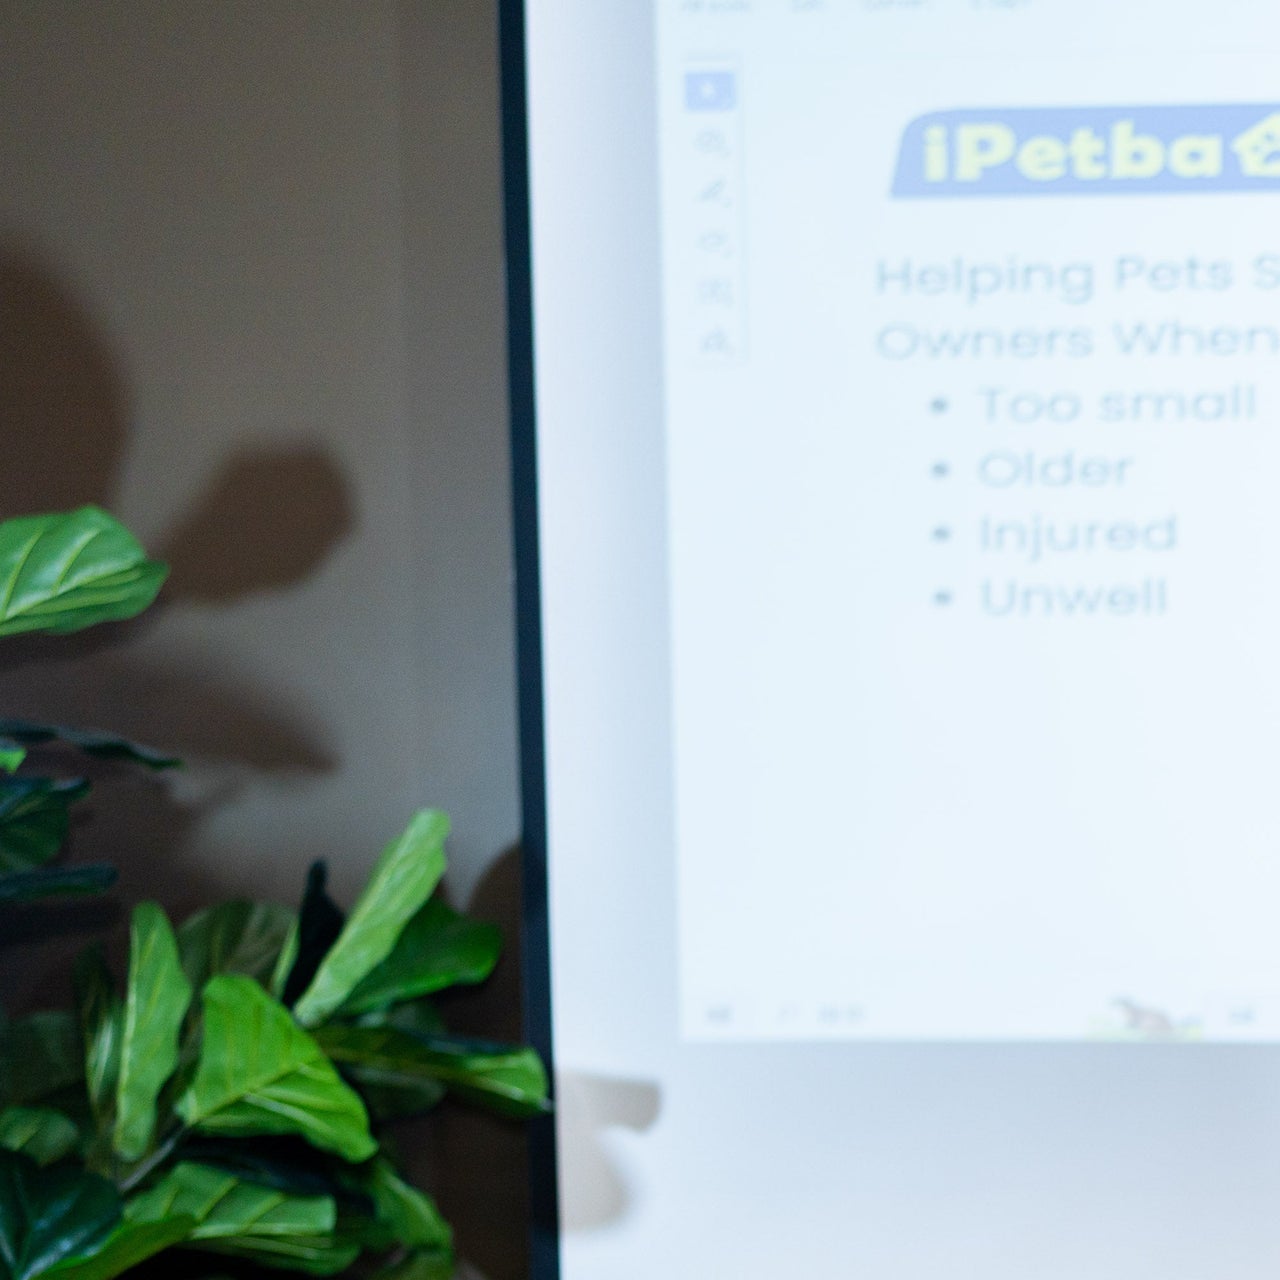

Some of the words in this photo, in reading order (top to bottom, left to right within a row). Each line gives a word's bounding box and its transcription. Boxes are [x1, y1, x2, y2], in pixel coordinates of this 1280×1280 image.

[922, 118, 1220, 183] iPetba
[875, 255, 1093, 304] Helping
[1115, 254, 1233, 293] Pets
[875, 320, 1093, 360] Owners
[1112, 318, 1280, 356] When
[976, 385, 1082, 423] Too
[1098, 382, 1258, 422] small
[977, 448, 1134, 489] Older
[979, 512, 1179, 561] Injured
[979, 576, 1168, 616] Unwell
